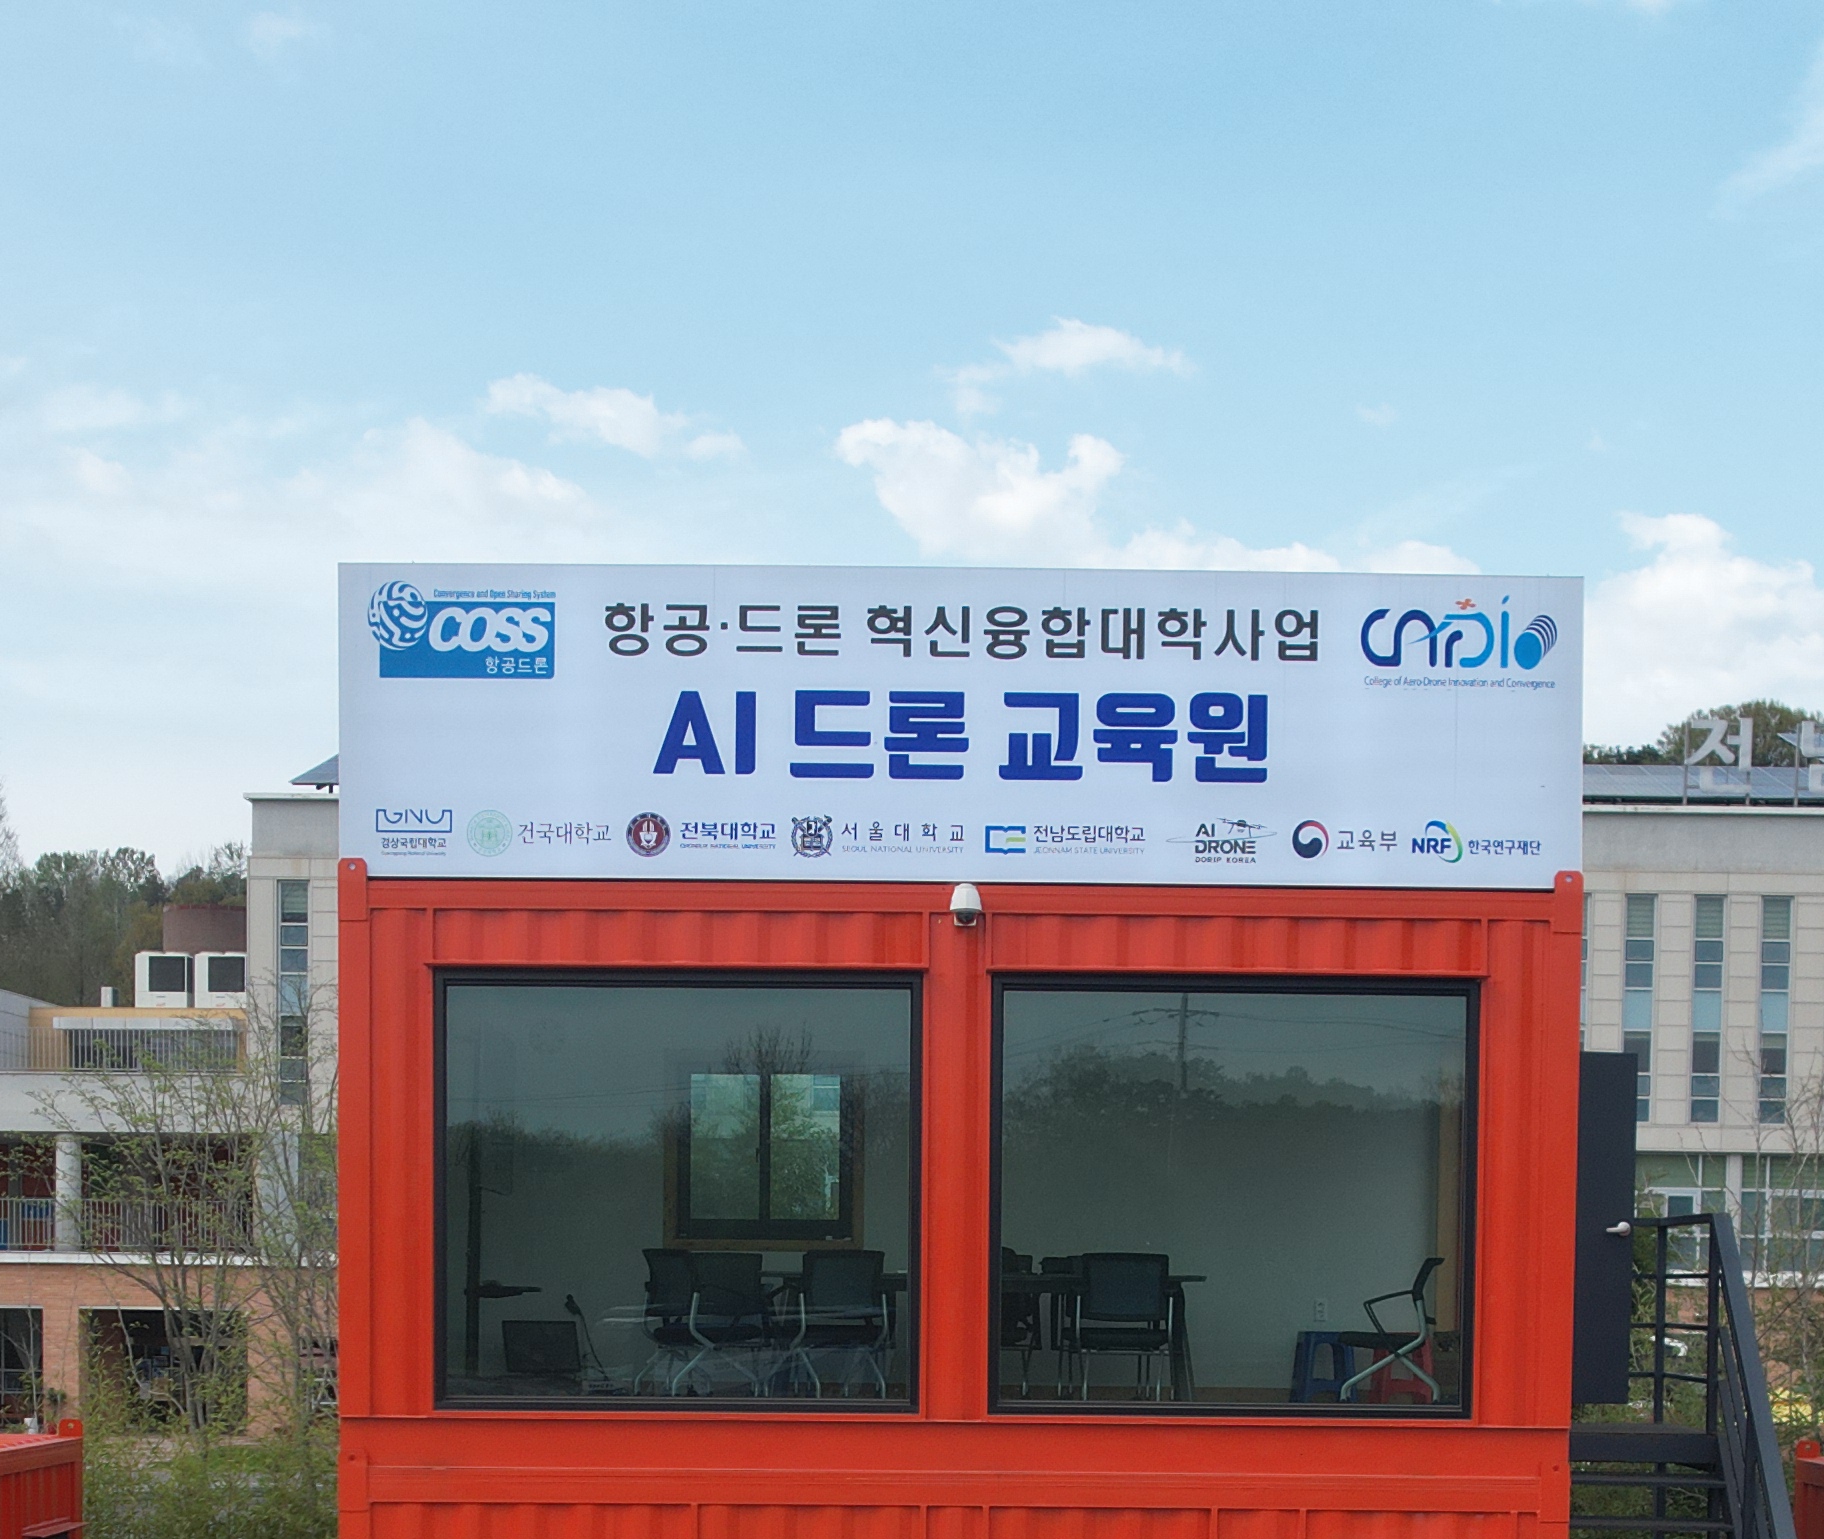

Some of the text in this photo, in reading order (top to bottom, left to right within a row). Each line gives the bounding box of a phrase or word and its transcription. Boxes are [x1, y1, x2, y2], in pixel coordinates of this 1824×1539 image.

[490, 588, 506, 600] Open
[507, 589, 532, 601] Sharing
[532, 589, 557, 601] System
[428, 607, 552, 652] COSS
[604, 602, 1320, 661] 항공·드론 혁신융합대학사업
[485, 656, 549, 675] 항공드론
[1364, 675, 1393, 688] College
[1393, 675, 1403, 686] of
[1448, 677, 1489, 688] Innovation
[1489, 678, 1505, 688] and
[1506, 678, 1556, 690] Convergence
[652, 689, 1268, 783] AI 드론 교육원
[517, 821, 612, 845] 건국대학교
[680, 821, 776, 841] 전북대학교
[1033, 825, 1146, 843] 전남도립대학교
[1195, 823, 1215, 838] AI
[381, 837, 447, 849] 경상국립대학교
[1194, 840, 1257, 855] DRONE
[1337, 829, 1398, 851] 교육부
[1411, 837, 1452, 854] NRF
[1468, 839, 1542, 856] 한국연구재단
[870, 845, 913, 853] NATIONAL
[916, 846, 964, 854] UNIVERSITY
[1033, 846, 1145, 855] JEONNAM STATE UNIVERSITY
[1226, 856, 1257, 864] KOREA
